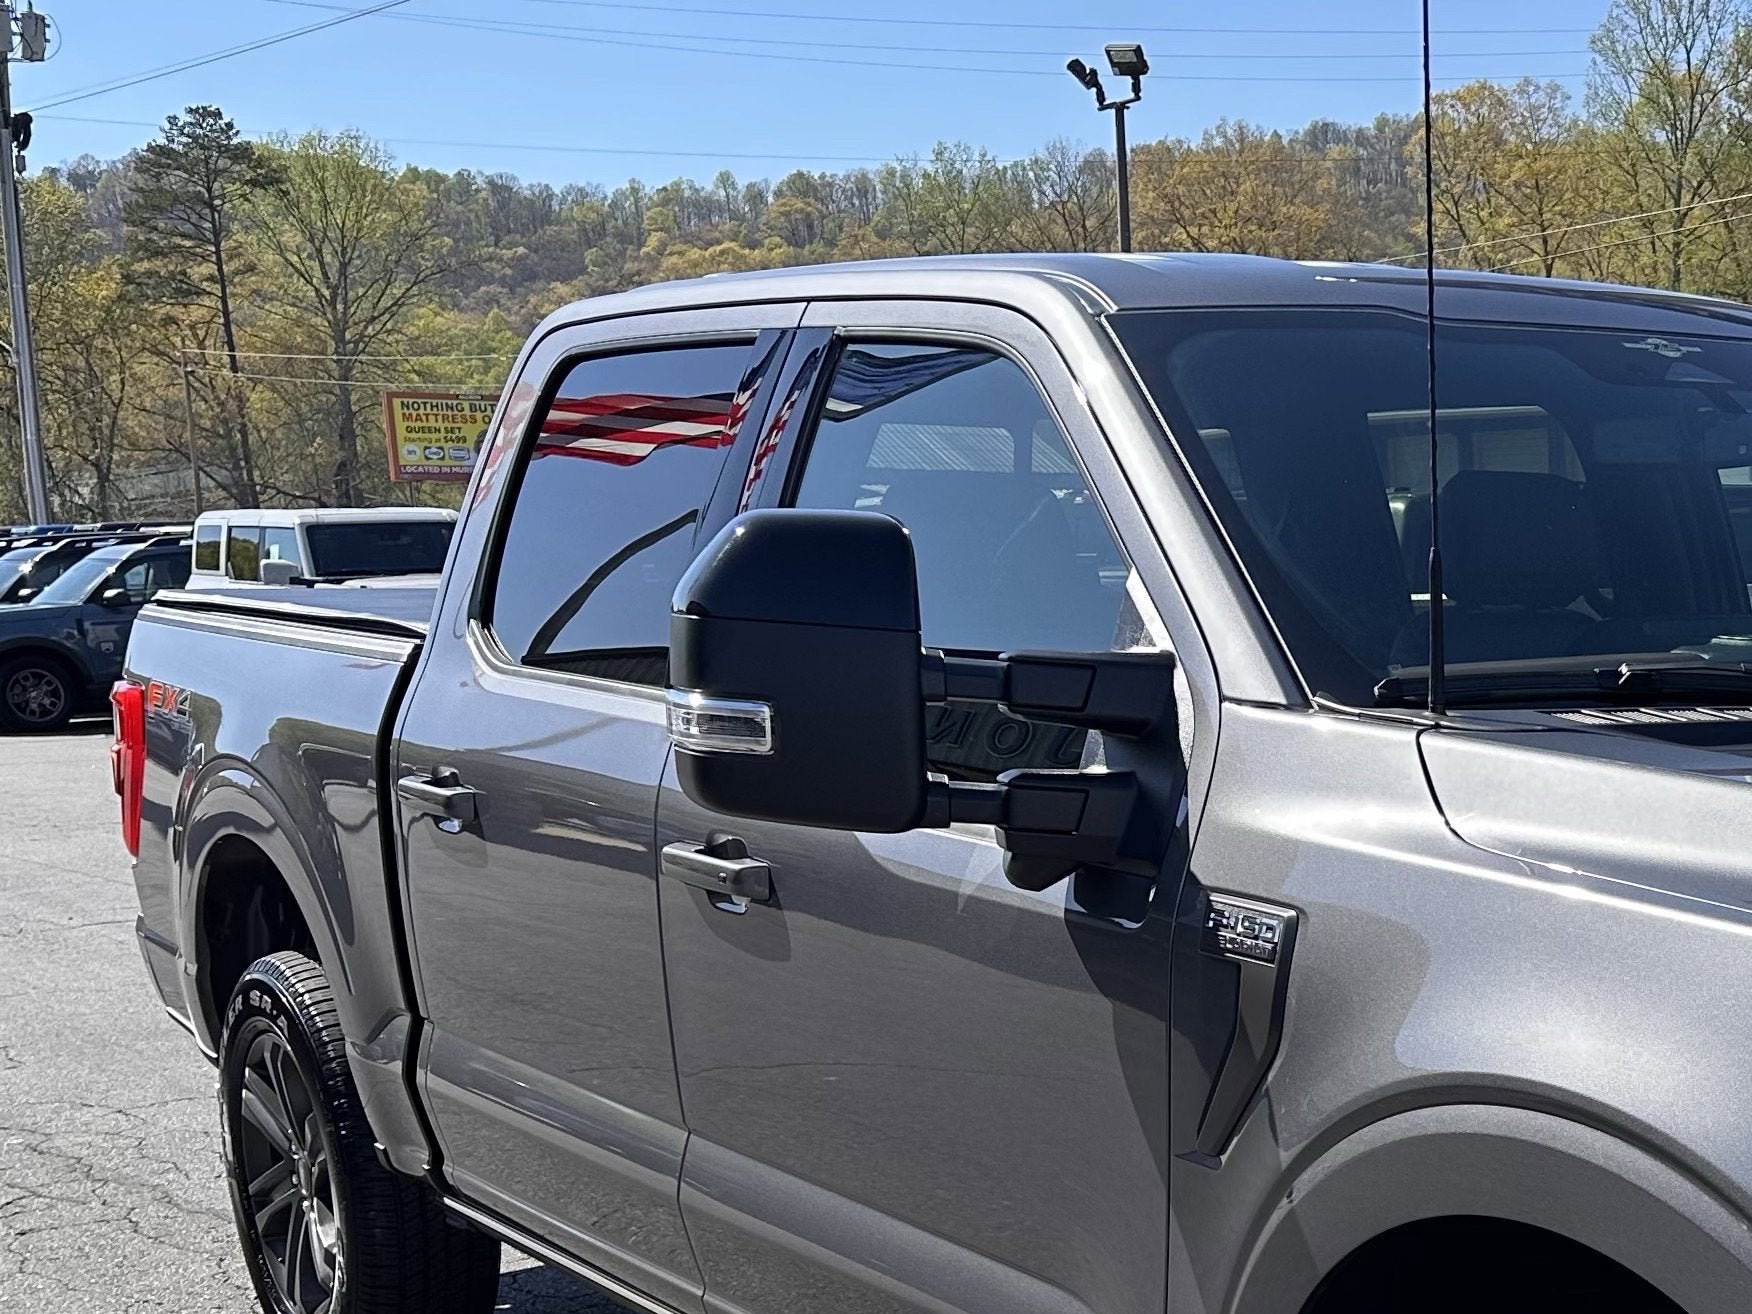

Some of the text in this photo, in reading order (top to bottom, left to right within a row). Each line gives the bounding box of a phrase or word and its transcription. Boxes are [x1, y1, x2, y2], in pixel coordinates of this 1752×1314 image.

[400, 400, 496, 413] NOTHING BUT
[402, 412, 477, 424] MATTRESS
[405, 425, 462, 434] QUEEN SET
[443, 435, 467, 444] $499
